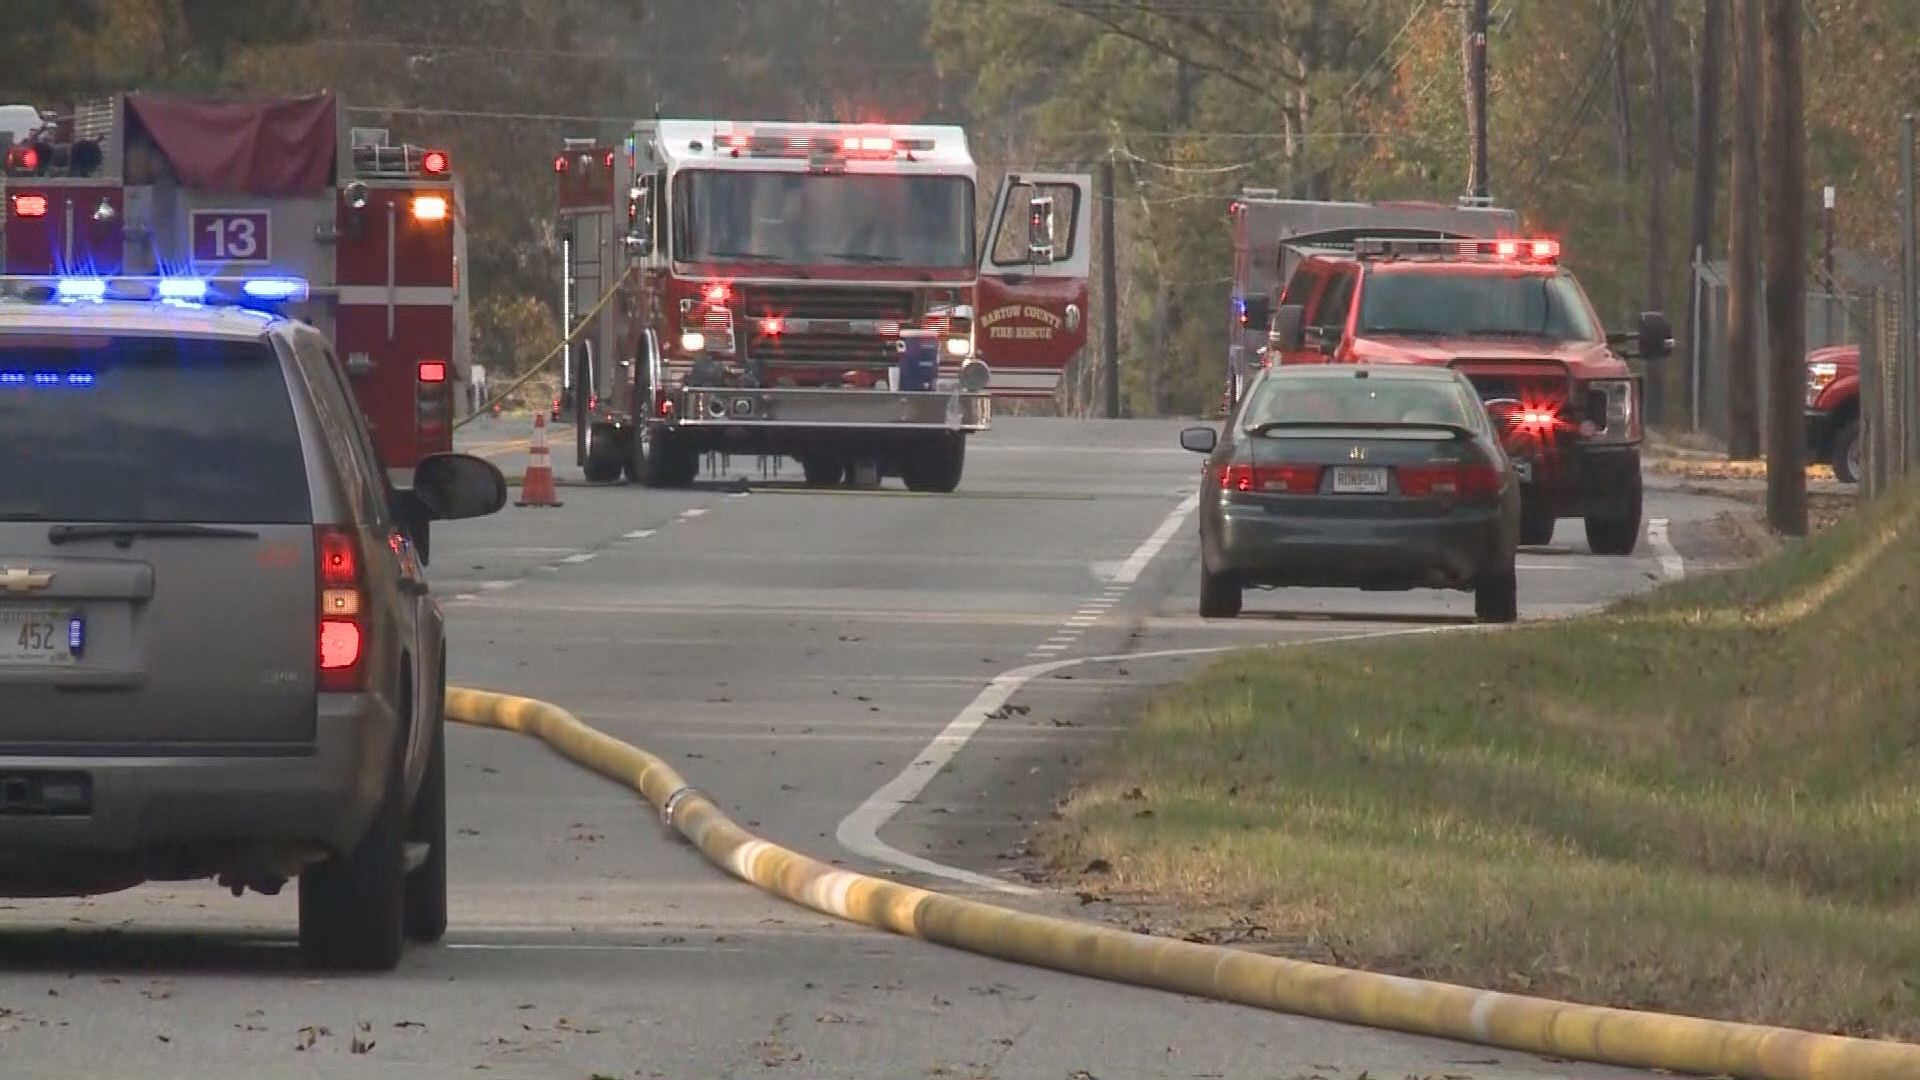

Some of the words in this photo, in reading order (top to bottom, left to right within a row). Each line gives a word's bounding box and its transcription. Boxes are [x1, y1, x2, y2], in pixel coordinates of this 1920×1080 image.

[206, 218, 257, 257] 13
[980, 304, 1021, 328] BARTOW
[1023, 305, 1062, 329] COUNTY
[17, 622, 55, 650] 452
